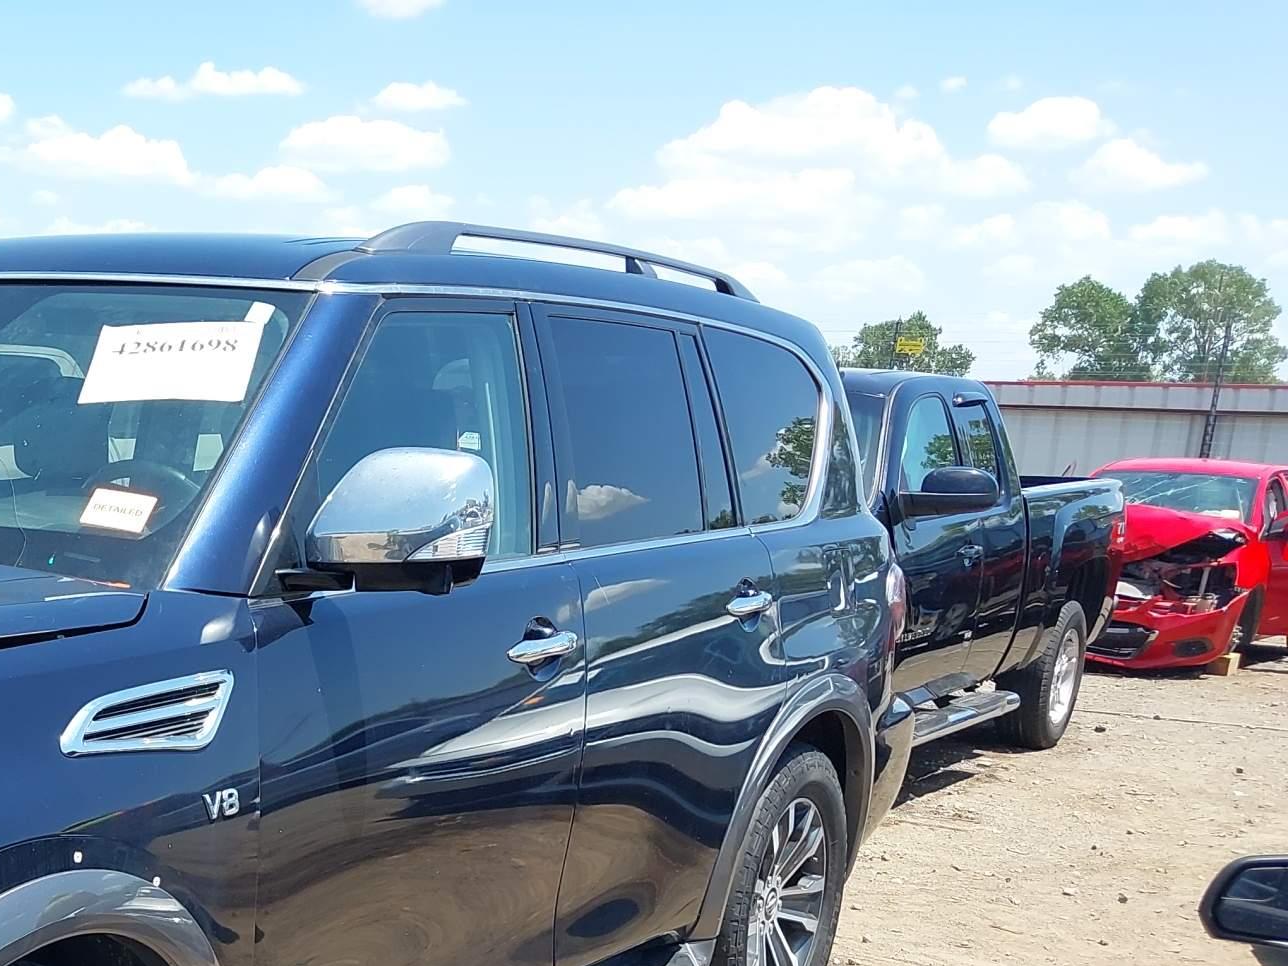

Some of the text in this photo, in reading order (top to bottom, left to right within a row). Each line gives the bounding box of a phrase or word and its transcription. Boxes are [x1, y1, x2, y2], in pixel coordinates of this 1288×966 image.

[112, 338, 239, 355] 42861698
[93, 503, 143, 517] DETAILED
[202, 788, 240, 820] V8
